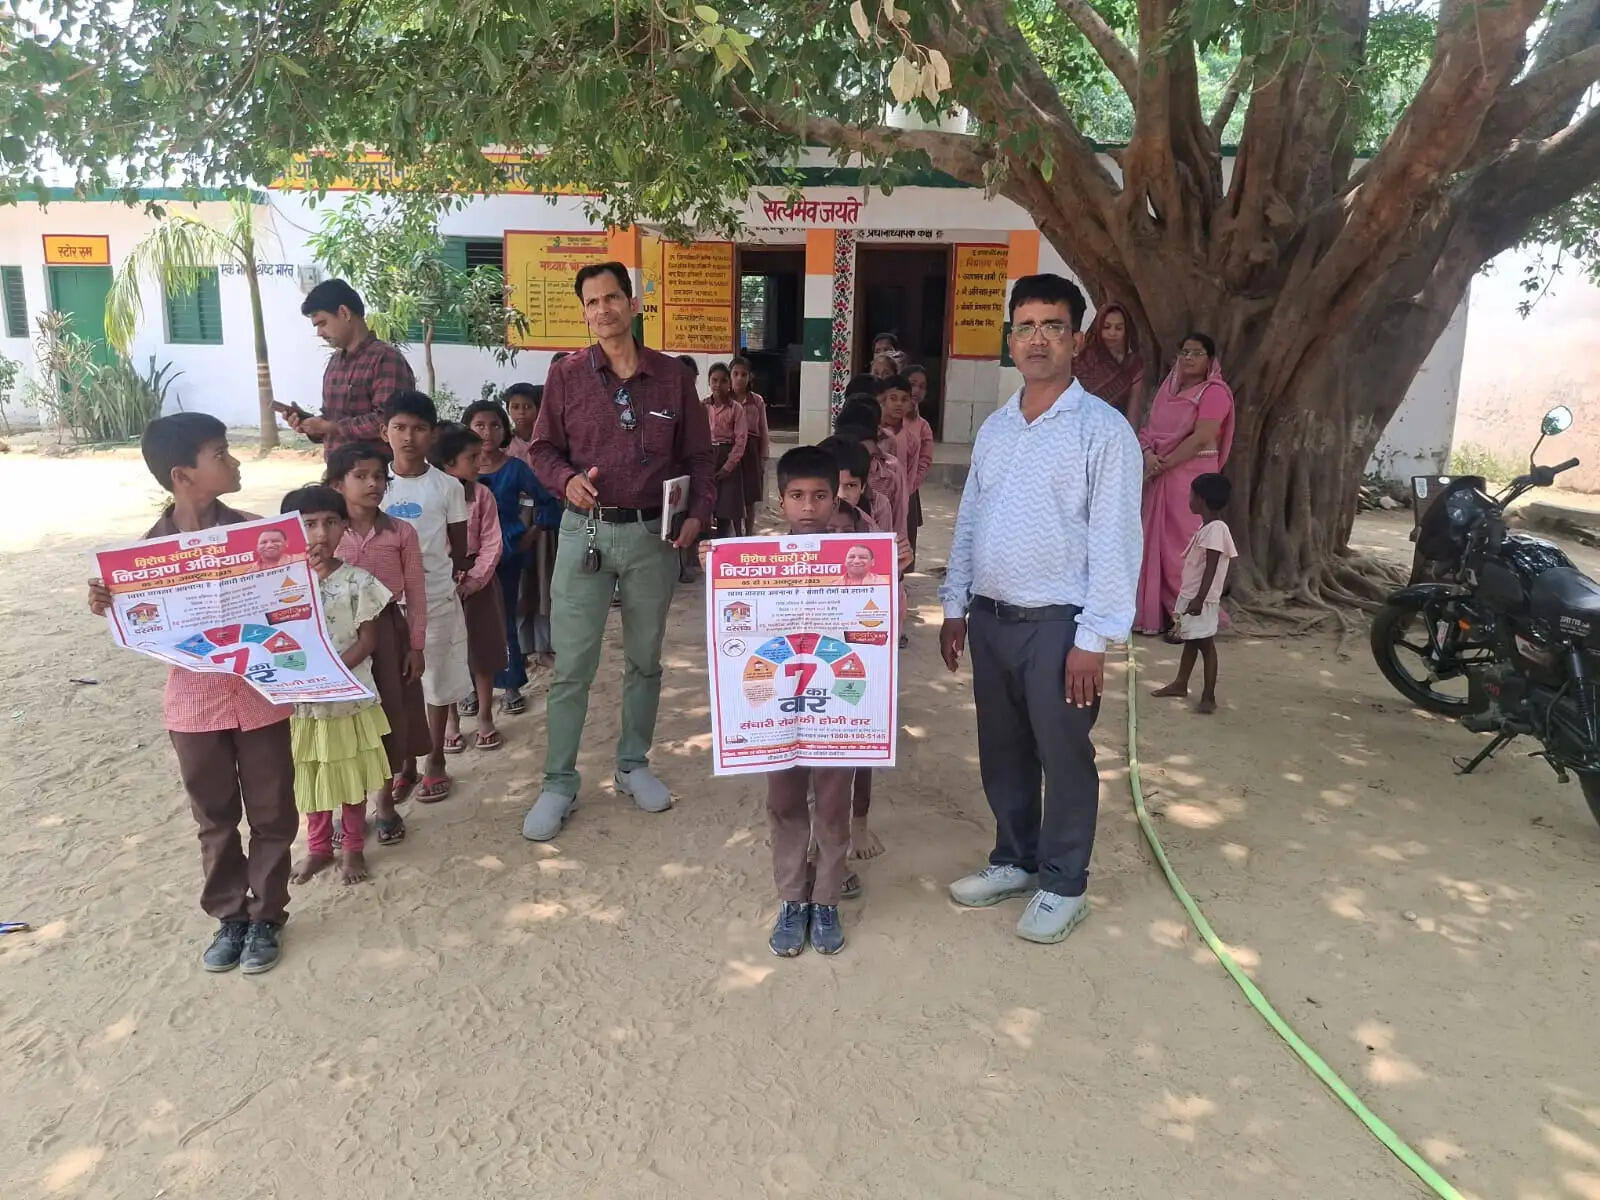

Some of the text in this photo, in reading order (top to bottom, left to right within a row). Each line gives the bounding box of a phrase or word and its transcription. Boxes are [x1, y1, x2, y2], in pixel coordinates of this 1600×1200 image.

[763, 194, 863, 224] सत्यमेव जयते
[57, 243, 77, 258] स्टोर
[275, 263, 294, 277] भारत
[134, 544, 227, 569] विशेष संचारी रोग
[185, 551, 256, 572] अभियान
[740, 551, 818, 564] विशेष संचारी रोग
[720, 562, 842, 577] नियंत्रण अभियान
[211, 646, 250, 675] 7
[249, 662, 271, 671] का
[784, 663, 817, 697] 7
[804, 688, 827, 697] का
[778, 695, 832, 714] वार
[740, 718, 774, 730] संचारी
[799, 714, 815, 725] की
[819, 715, 847, 726] होगी
[850, 717, 872, 726] हार
